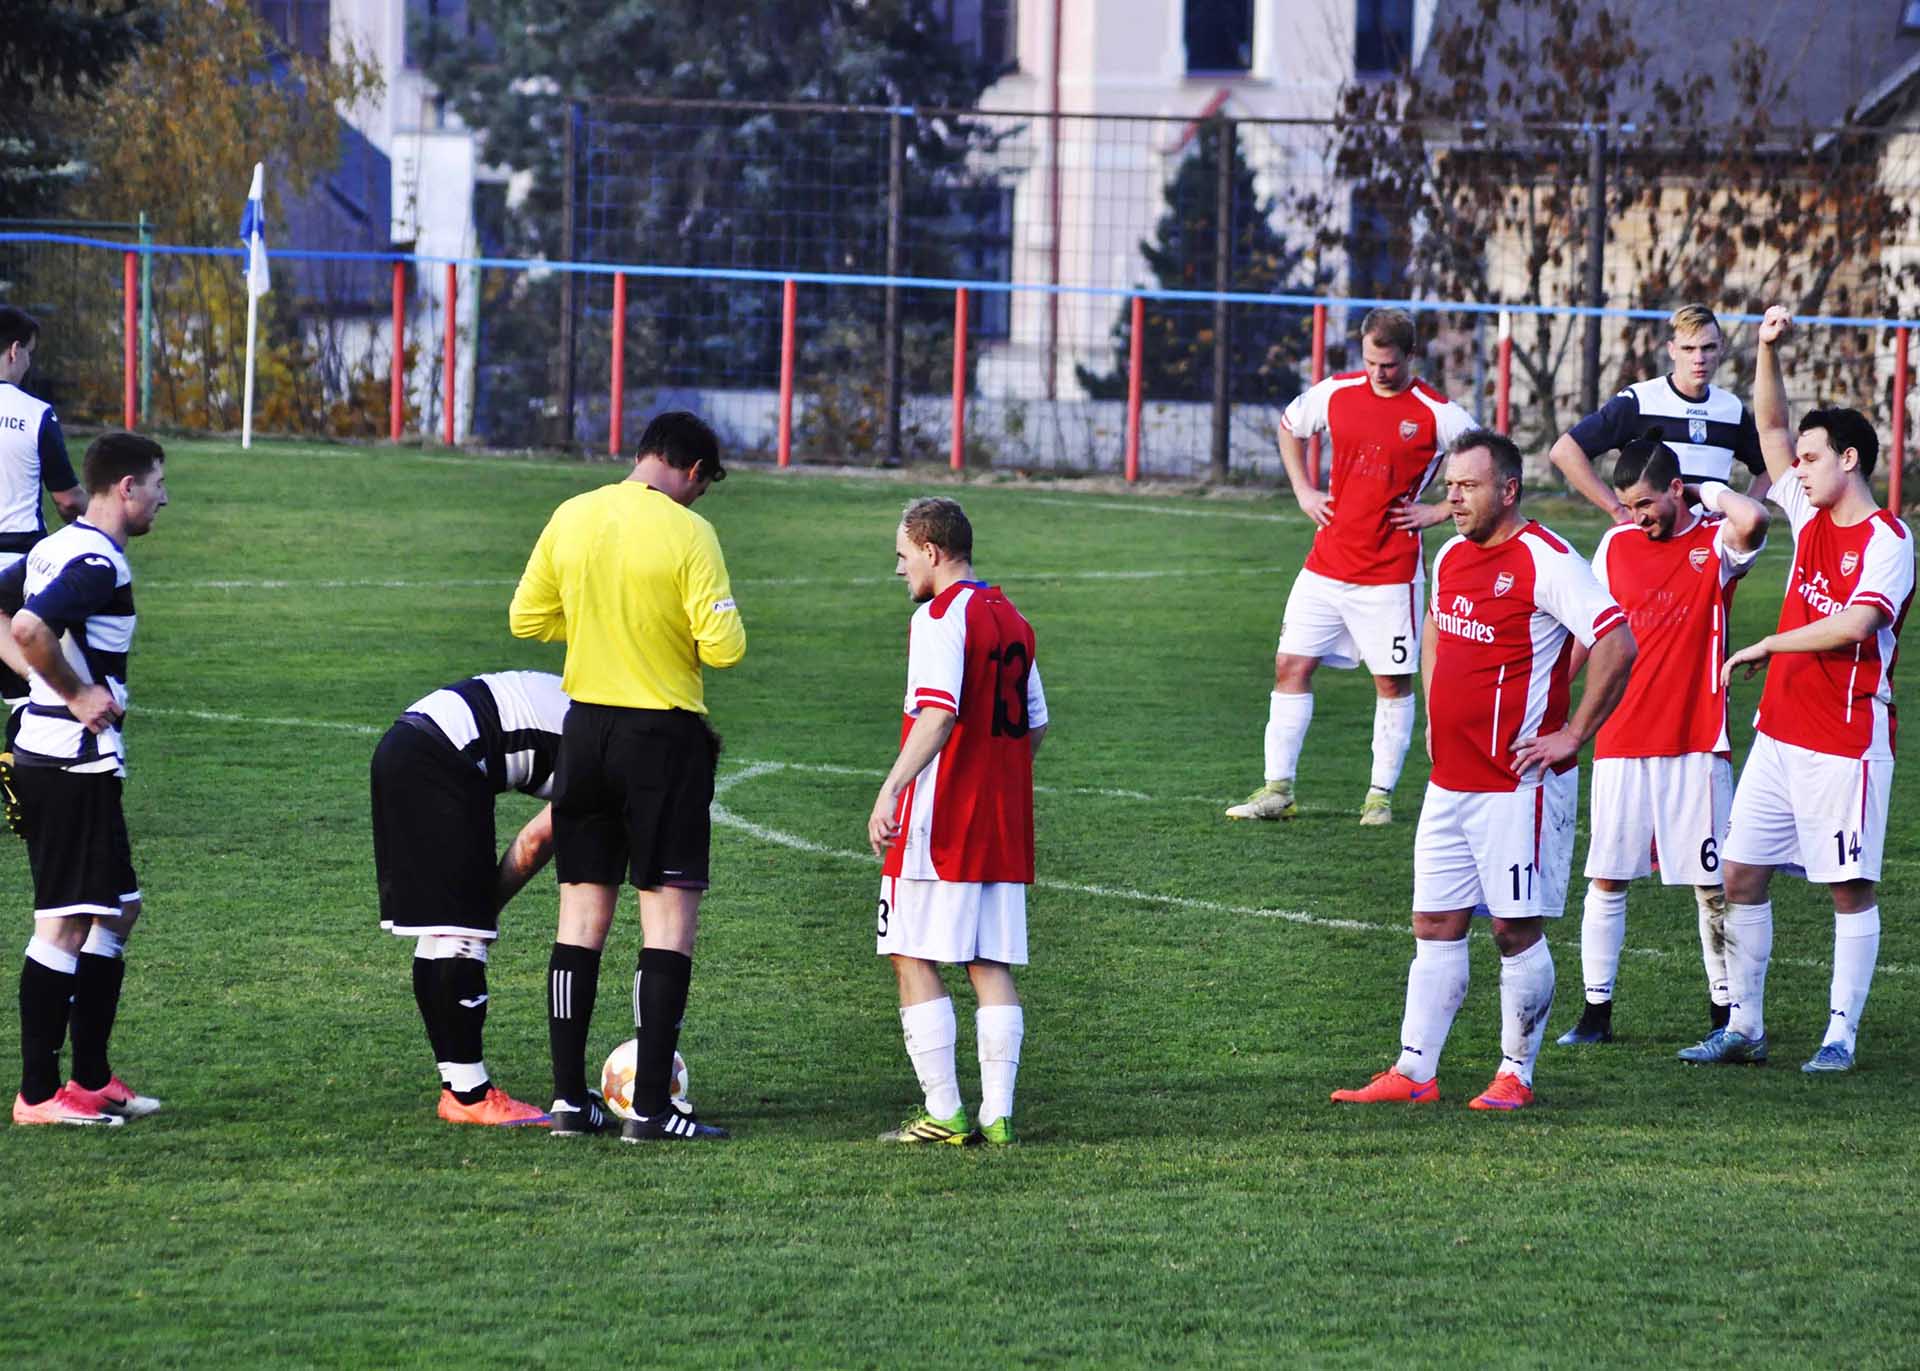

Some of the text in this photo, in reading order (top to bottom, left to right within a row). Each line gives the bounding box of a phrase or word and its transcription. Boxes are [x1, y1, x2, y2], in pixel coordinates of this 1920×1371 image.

[1452, 595, 1474, 617] Fly
[1392, 635, 1407, 664] 5
[988, 641, 1028, 739] 13
[1700, 837, 1719, 873] 6
[1833, 830, 1863, 866] 14
[1509, 862, 1533, 901] 11
